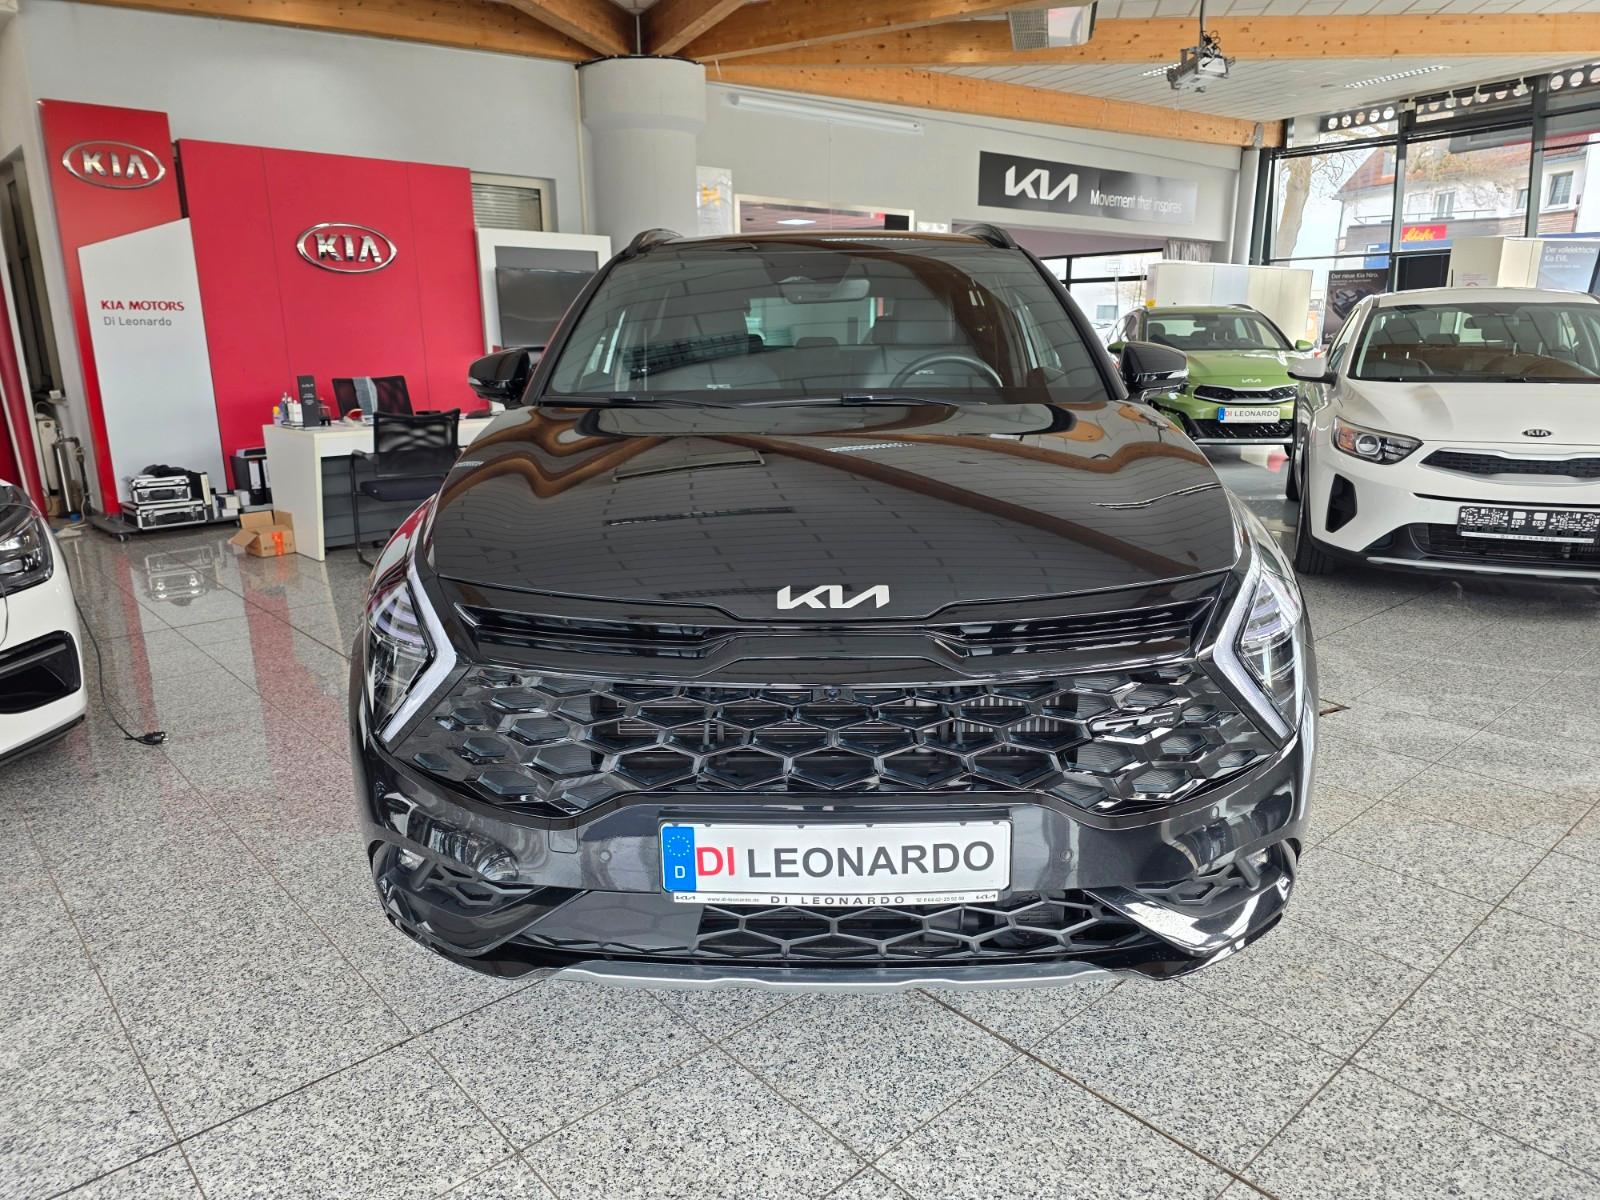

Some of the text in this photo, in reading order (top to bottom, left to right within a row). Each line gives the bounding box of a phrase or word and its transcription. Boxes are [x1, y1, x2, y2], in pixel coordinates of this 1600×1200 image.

[82, 150, 149, 180] KIA
[1005, 165, 1079, 202] KIA
[1090, 189, 1136, 209] Movement
[314, 233, 382, 263] KIA
[101, 300, 185, 311] KIA MOTORS
[103, 316, 172, 326] Di Leonardo
[777, 585, 890, 610] KIA
[696, 841, 994, 878] DI LEONARDO
[674, 865, 686, 879] D
[770, 895, 788, 904] DI
[801, 895, 904, 905] LEONARDO
